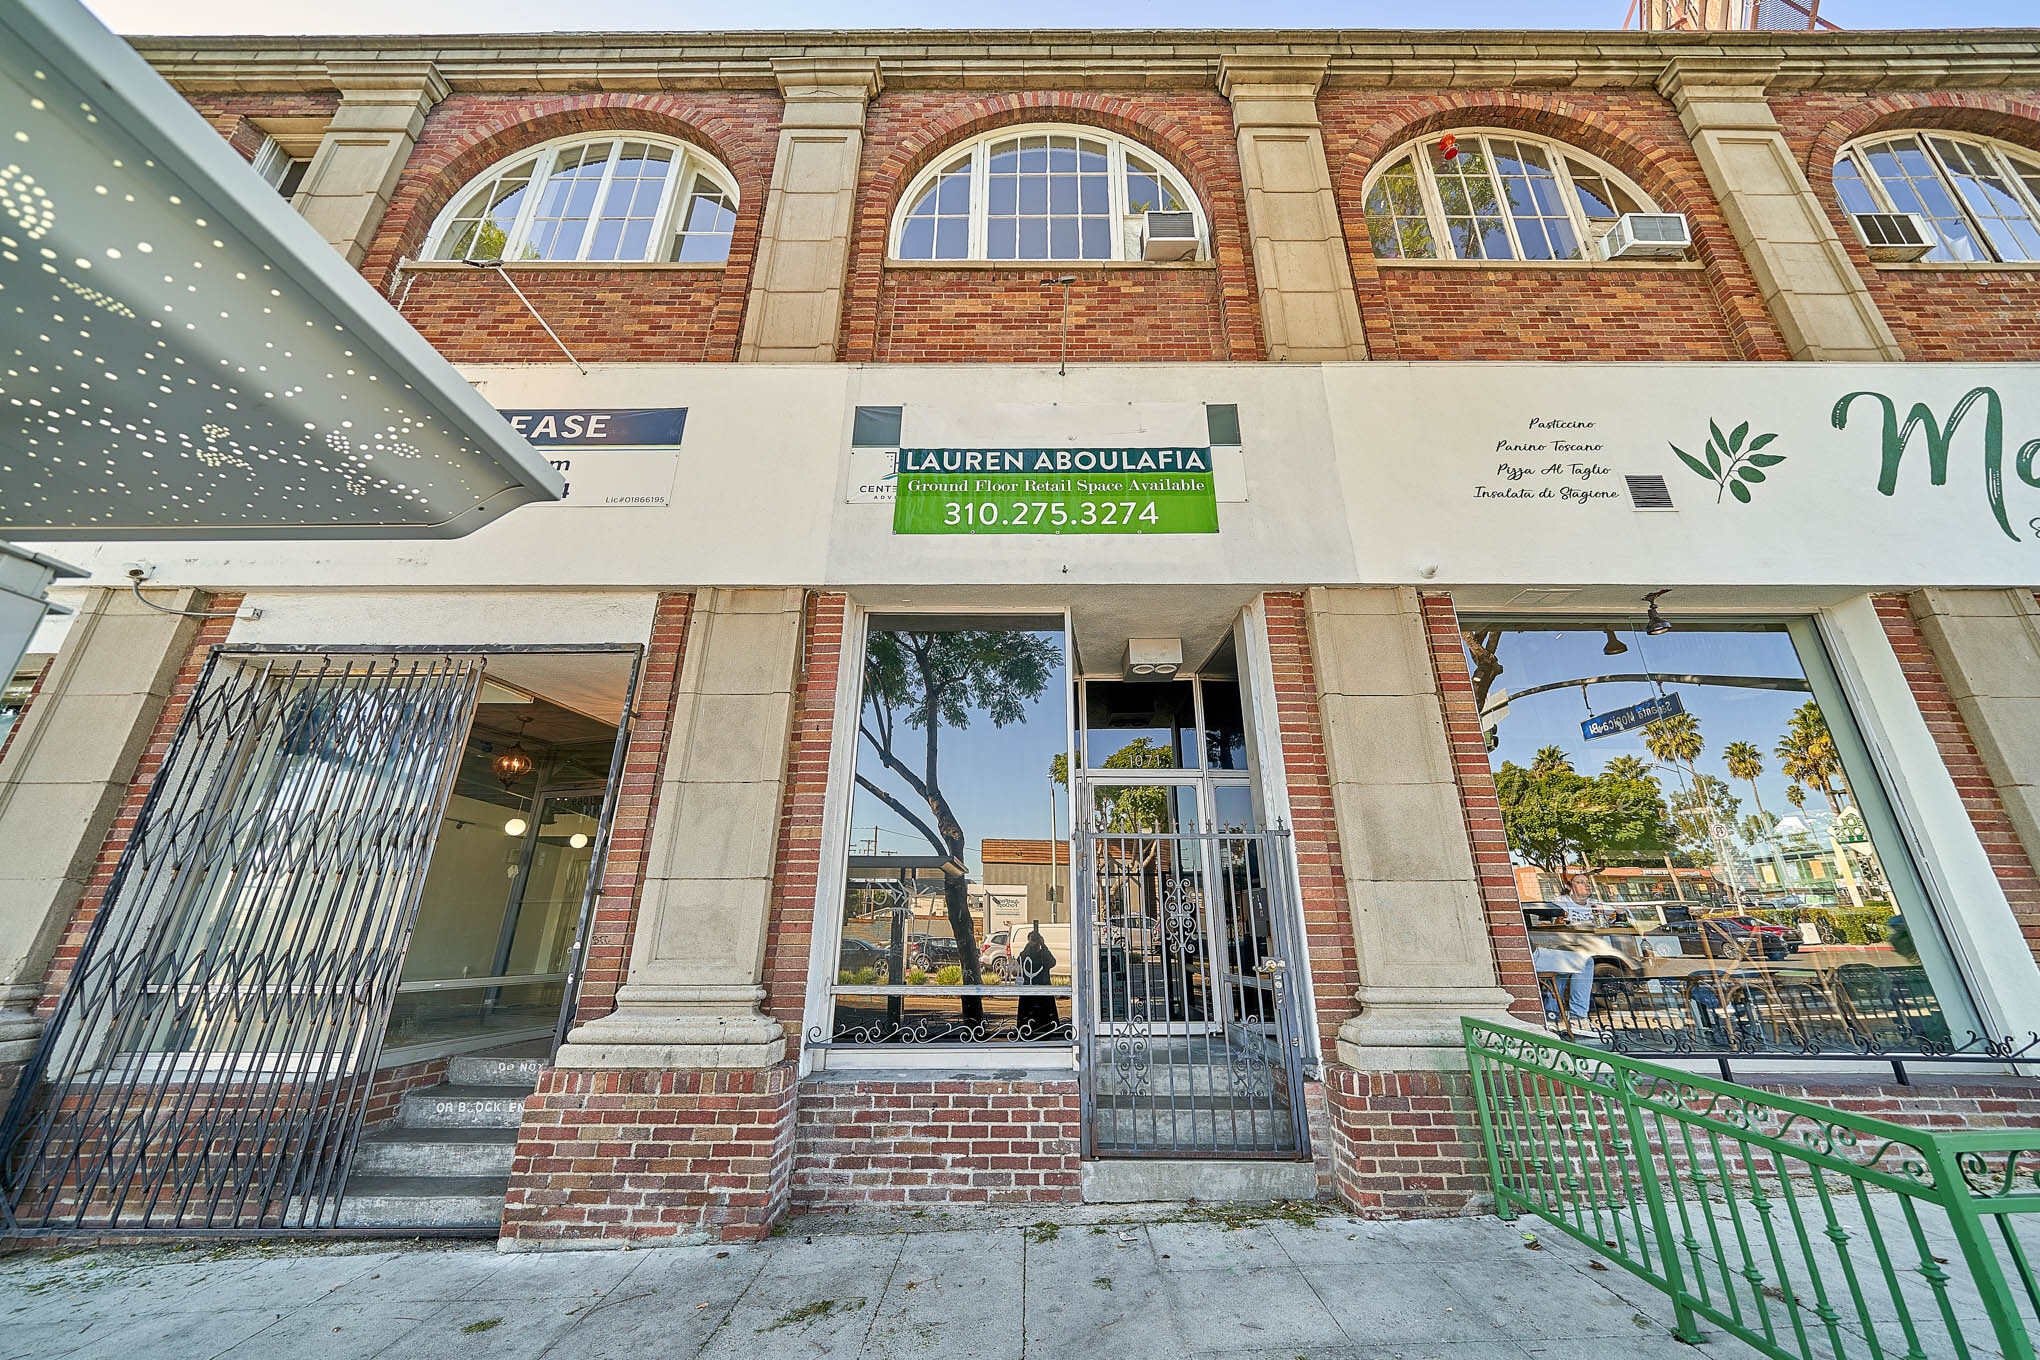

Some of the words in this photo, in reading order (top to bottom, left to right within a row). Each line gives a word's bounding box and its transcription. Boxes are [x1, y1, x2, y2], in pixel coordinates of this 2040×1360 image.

[1529, 417, 1596, 430] Pasticcino
[1496, 440, 1547, 453] Panino
[1550, 440, 1603, 452] Toscano
[906, 450, 1024, 472] LAUREN
[1034, 450, 1206, 471] ABOULAFIA
[1496, 463, 1535, 480] Pizza
[1541, 463, 1564, 475] Al
[1567, 463, 1612, 480] Taglio
[908, 479, 970, 493] Ground
[974, 478, 1019, 493] Floor
[1024, 478, 1071, 492] Retail
[1077, 478, 1123, 494] Space
[1128, 477, 1204, 492] Available
[605, 496, 665, 504] Lic#01866195
[1473, 486, 1534, 499] Insalata
[1539, 486, 1555, 499] di
[1560, 486, 1619, 504] Stagione
[943, 501, 1160, 526] 310.275.3274
[1128, 754, 1160, 767] 1071
[498, 1062, 515, 1072] DO
[436, 1102, 453, 1113] OR
